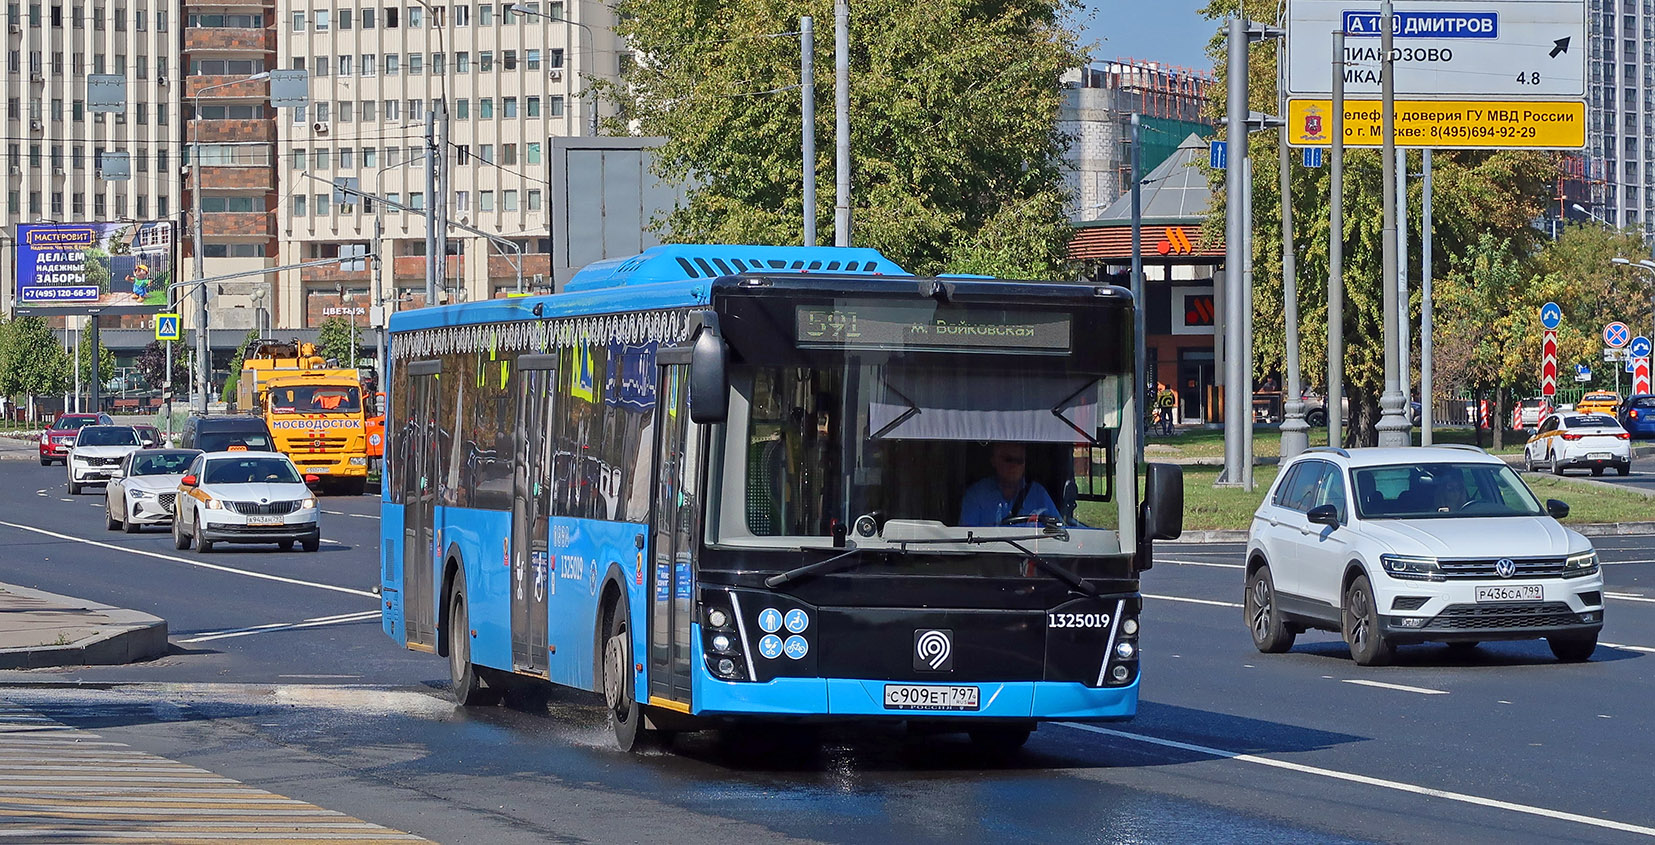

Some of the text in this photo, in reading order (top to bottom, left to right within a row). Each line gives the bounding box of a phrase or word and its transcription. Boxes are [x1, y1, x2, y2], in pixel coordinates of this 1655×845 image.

[1404, 18, 1494, 34] ДМИТРОВ
[1516, 71, 1541, 85] 4.8
[1341, 109, 1574, 123] елефн доверия ГУ МВД России
[1357, 128, 1366, 136] г.
[1370, 125, 1426, 137] Мскве:
[1430, 125, 1536, 139] 8(495)694-92-29
[34, 233, 89, 241] МАСТЕРОВИТ
[36, 252, 85, 264] ДЕЛАЕМ
[36, 264, 85, 273] НАДЕЖНЫЕ
[36, 273, 85, 283] ЗАБОРЫ
[35, 289, 56, 298] (495)
[57, 289, 97, 297] 120-66-99
[322, 307, 356, 317] ЦВЕТЫ
[273, 420, 361, 429] МОСВОДОСТОК
[1523, 586, 1540, 595] 799
[1048, 613, 1110, 628] 1325019
[890, 688, 974, 704] С909ЕТ 797
